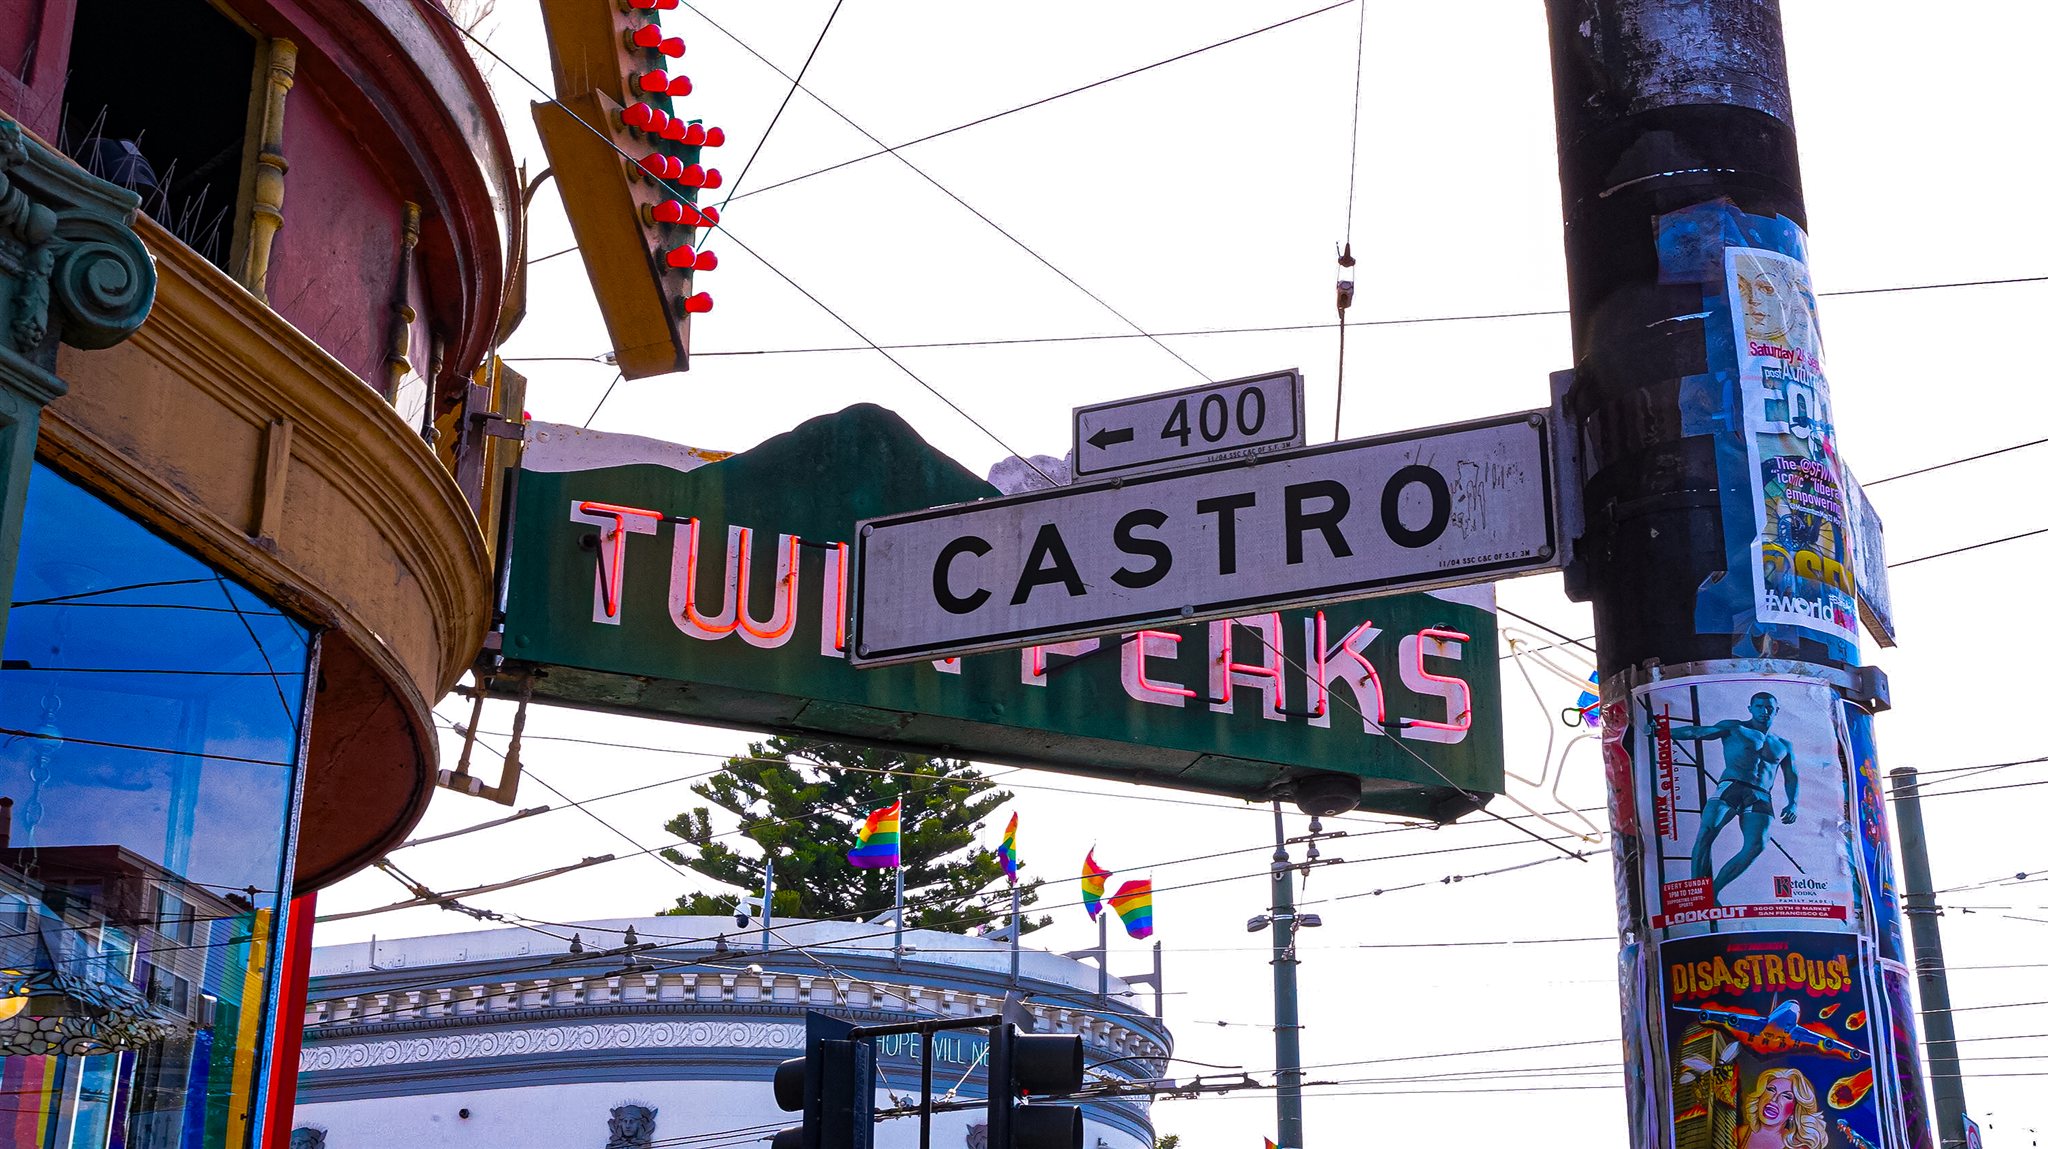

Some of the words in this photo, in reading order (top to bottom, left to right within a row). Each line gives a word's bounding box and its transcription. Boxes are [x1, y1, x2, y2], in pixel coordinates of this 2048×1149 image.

[1750, 341, 1795, 364] Saturday
[1764, 367, 1781, 379] post
[1161, 386, 1266, 447] 400
[1774, 456, 1797, 471] The
[932, 464, 1452, 614] CASTRO
[1439, 558, 1460, 568] 11/04
[1462, 556, 1475, 564] SSC
[1477, 554, 1492, 562] C&C
[1494, 552, 1502, 560] OF
[1504, 551, 1518, 559] S.F.
[1520, 549, 1530, 557] 3M
[1664, 883, 1682, 892] EVERY
[1684, 879, 1709, 888] SUNDAY
[1774, 877, 1806, 897] Ketel
[1807, 879, 1828, 890] One
[1665, 907, 1747, 926] LOOKOUT
[1672, 952, 1852, 996] DISASTROUS!
